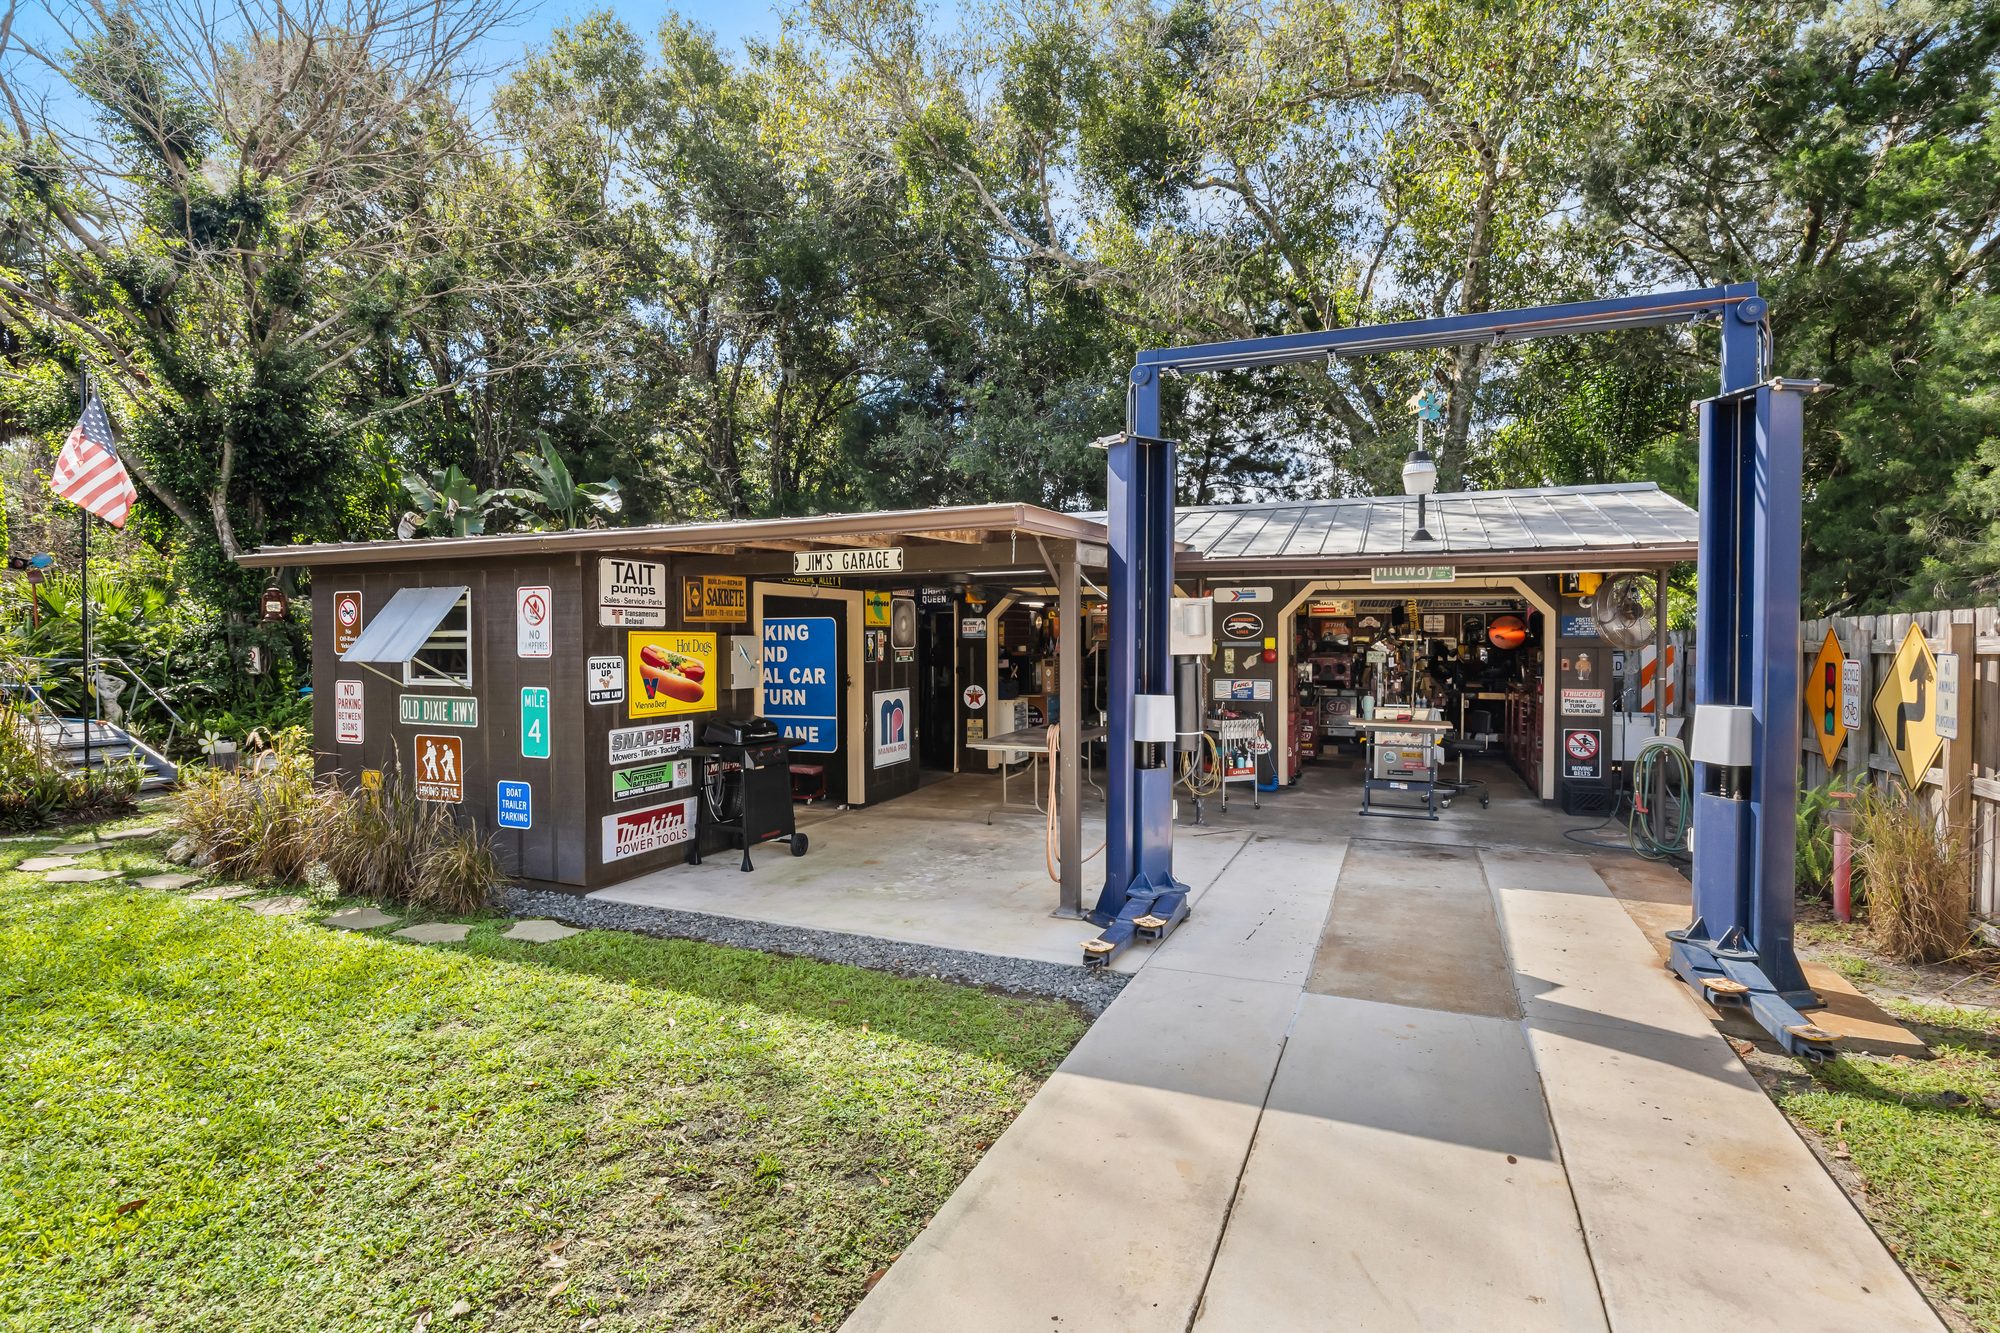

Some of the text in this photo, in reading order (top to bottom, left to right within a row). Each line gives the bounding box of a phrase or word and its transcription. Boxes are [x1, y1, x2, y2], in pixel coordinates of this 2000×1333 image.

[805, 551, 890, 571] JIM'S GARAGE
[611, 561, 656, 585] TAIT
[611, 584, 656, 597] pumps
[604, 595, 663, 606] Sales Service Parts
[706, 588, 744, 607] SAKRETE
[922, 595, 947, 604] QUEEN
[625, 609, 659, 618] Transamerica
[529, 630, 540, 640] NO
[763, 624, 809, 641] KING
[676, 639, 713, 656] Hot Dogs
[764, 646, 788, 662] ND
[590, 662, 621, 670] BUCKLE
[763, 667, 827, 684] AL CAR
[1844, 668, 1859, 681] BICYCLE
[344, 684, 355, 696] NO
[591, 690, 622, 700] IT'S THE LAW
[1843, 684, 1859, 695] PARKING
[337, 698, 362, 710] PARKING
[524, 694, 545, 708] MILE
[635, 700, 667, 710] Vienna Beef
[1329, 701, 1347, 711] STP
[338, 711, 362, 721] BETWEEN
[402, 699, 474, 722] OLD DIXIE HWY
[342, 723, 358, 731] SIGNS
[528, 718, 542, 743] 4
[611, 727, 680, 751] SNAPPER
[783, 725, 819, 743] ANE
[612, 745, 681, 762] Mowers Tillers Tractors
[878, 743, 908, 756] MANNA PRO
[632, 777, 663, 788] BATTERIES
[633, 770, 665, 782] INTERSTATE
[419, 785, 459, 798] HIKING TRAIL
[506, 788, 522, 798] BOAT
[501, 799, 527, 811] TRAILER
[501, 811, 528, 823] PARKING
[618, 812, 683, 843] makita
[616, 828, 688, 857] POWER TOOLS
